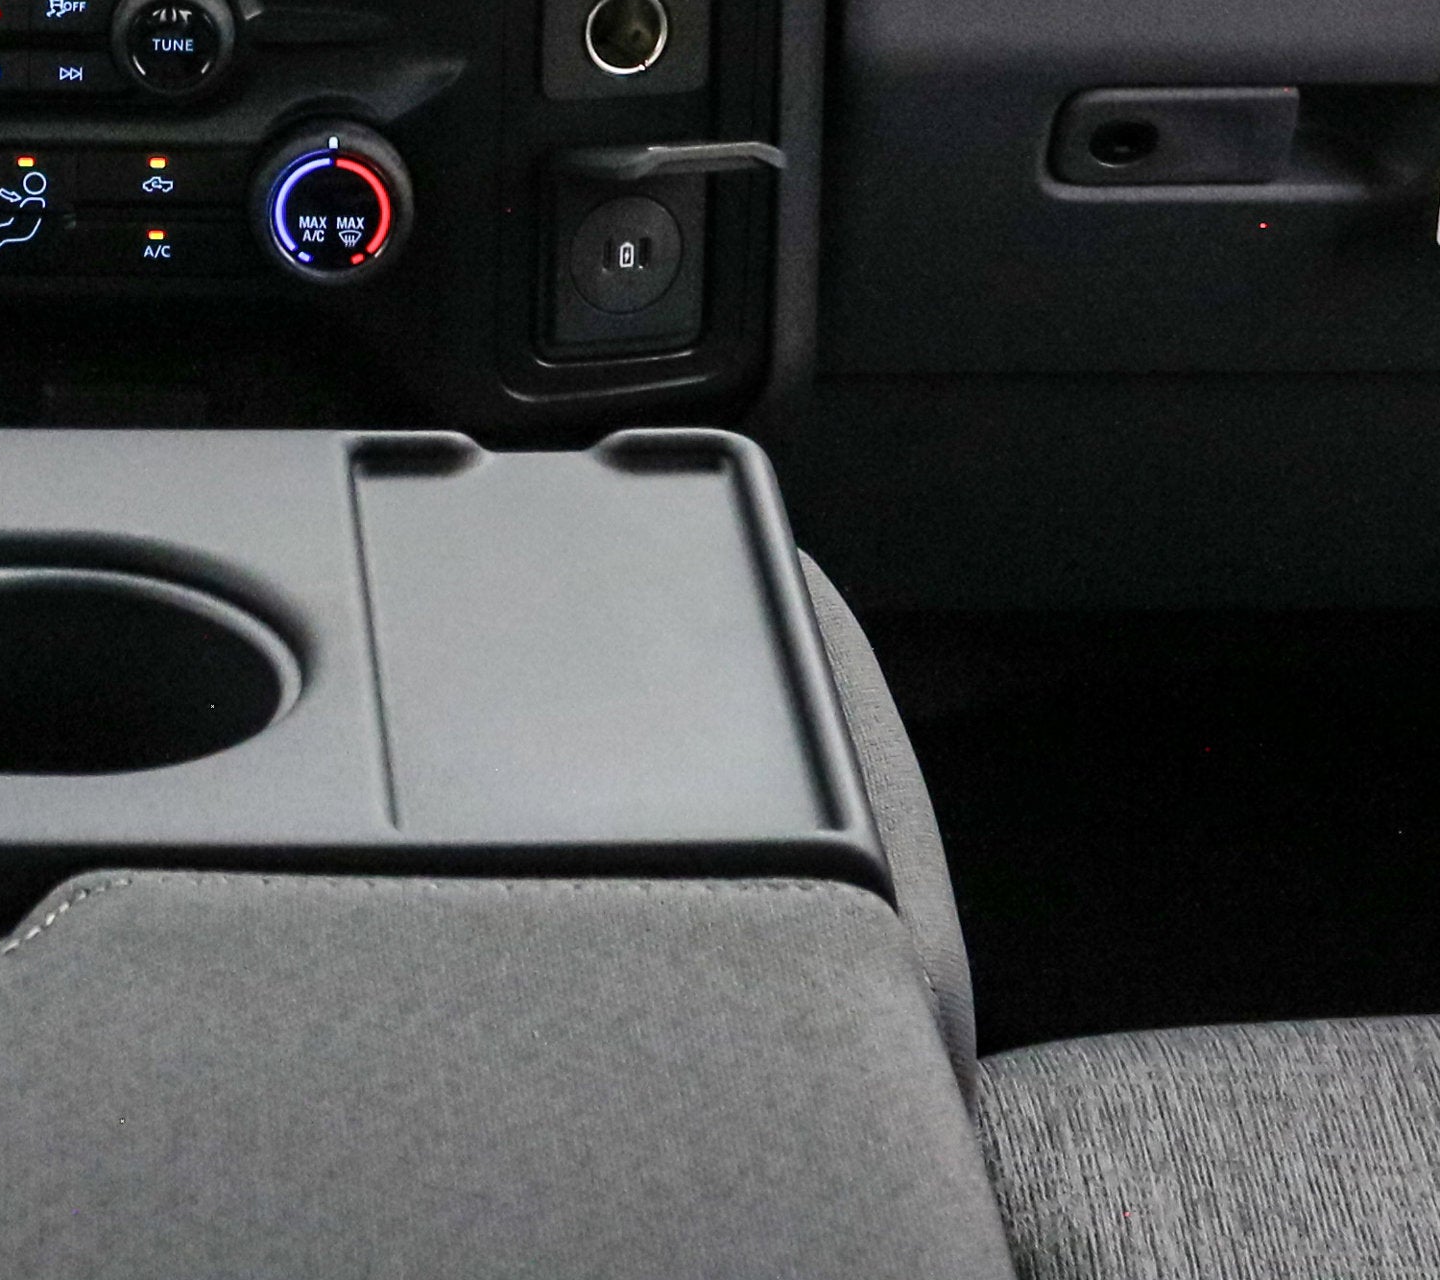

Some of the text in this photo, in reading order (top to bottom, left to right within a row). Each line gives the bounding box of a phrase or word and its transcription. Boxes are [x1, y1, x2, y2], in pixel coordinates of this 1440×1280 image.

[63, 0, 86, 13] OFF
[152, 38, 194, 52] TUNE
[299, 216, 326, 229] MAX
[336, 216, 365, 229] MAX
[303, 229, 325, 242] A/C
[143, 245, 171, 258] A/C
